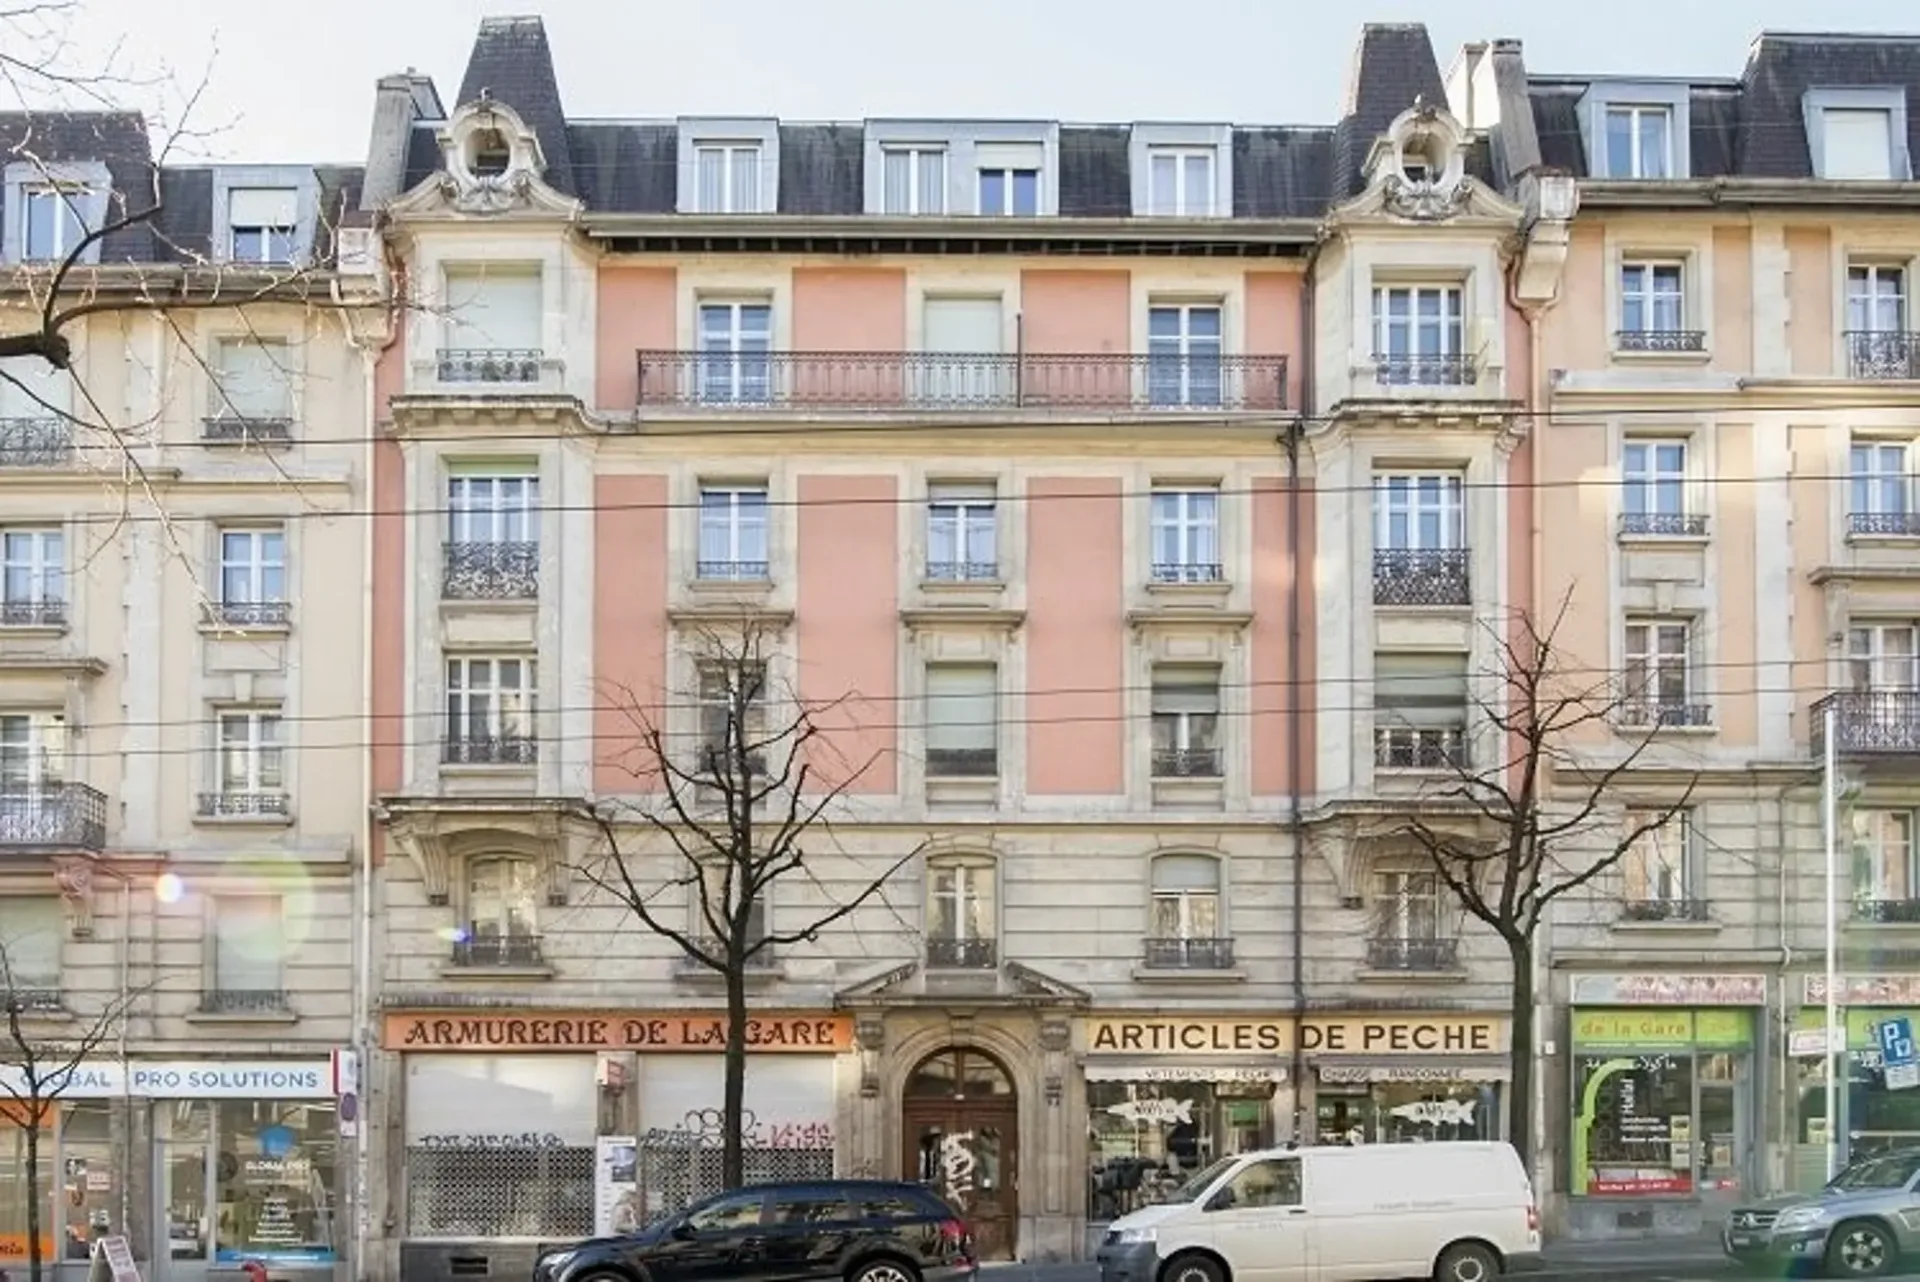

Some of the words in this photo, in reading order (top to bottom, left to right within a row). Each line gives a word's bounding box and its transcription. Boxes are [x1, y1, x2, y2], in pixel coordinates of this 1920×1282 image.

[404, 1019, 609, 1045] ARMURERIE
[622, 1019, 668, 1045] DE
[681, 1020, 727, 1045] LA
[743, 1020, 836, 1045] GARE
[1094, 1024, 1281, 1050] ARTICLES
[1300, 1024, 1346, 1050] DE
[1363, 1024, 1491, 1050] PECHE
[1580, 1020, 1605, 1037] de
[1883, 1022, 1900, 1050] P
[135, 1071, 180, 1088] PRO
[188, 1071, 319, 1088] SOLUTIONS
